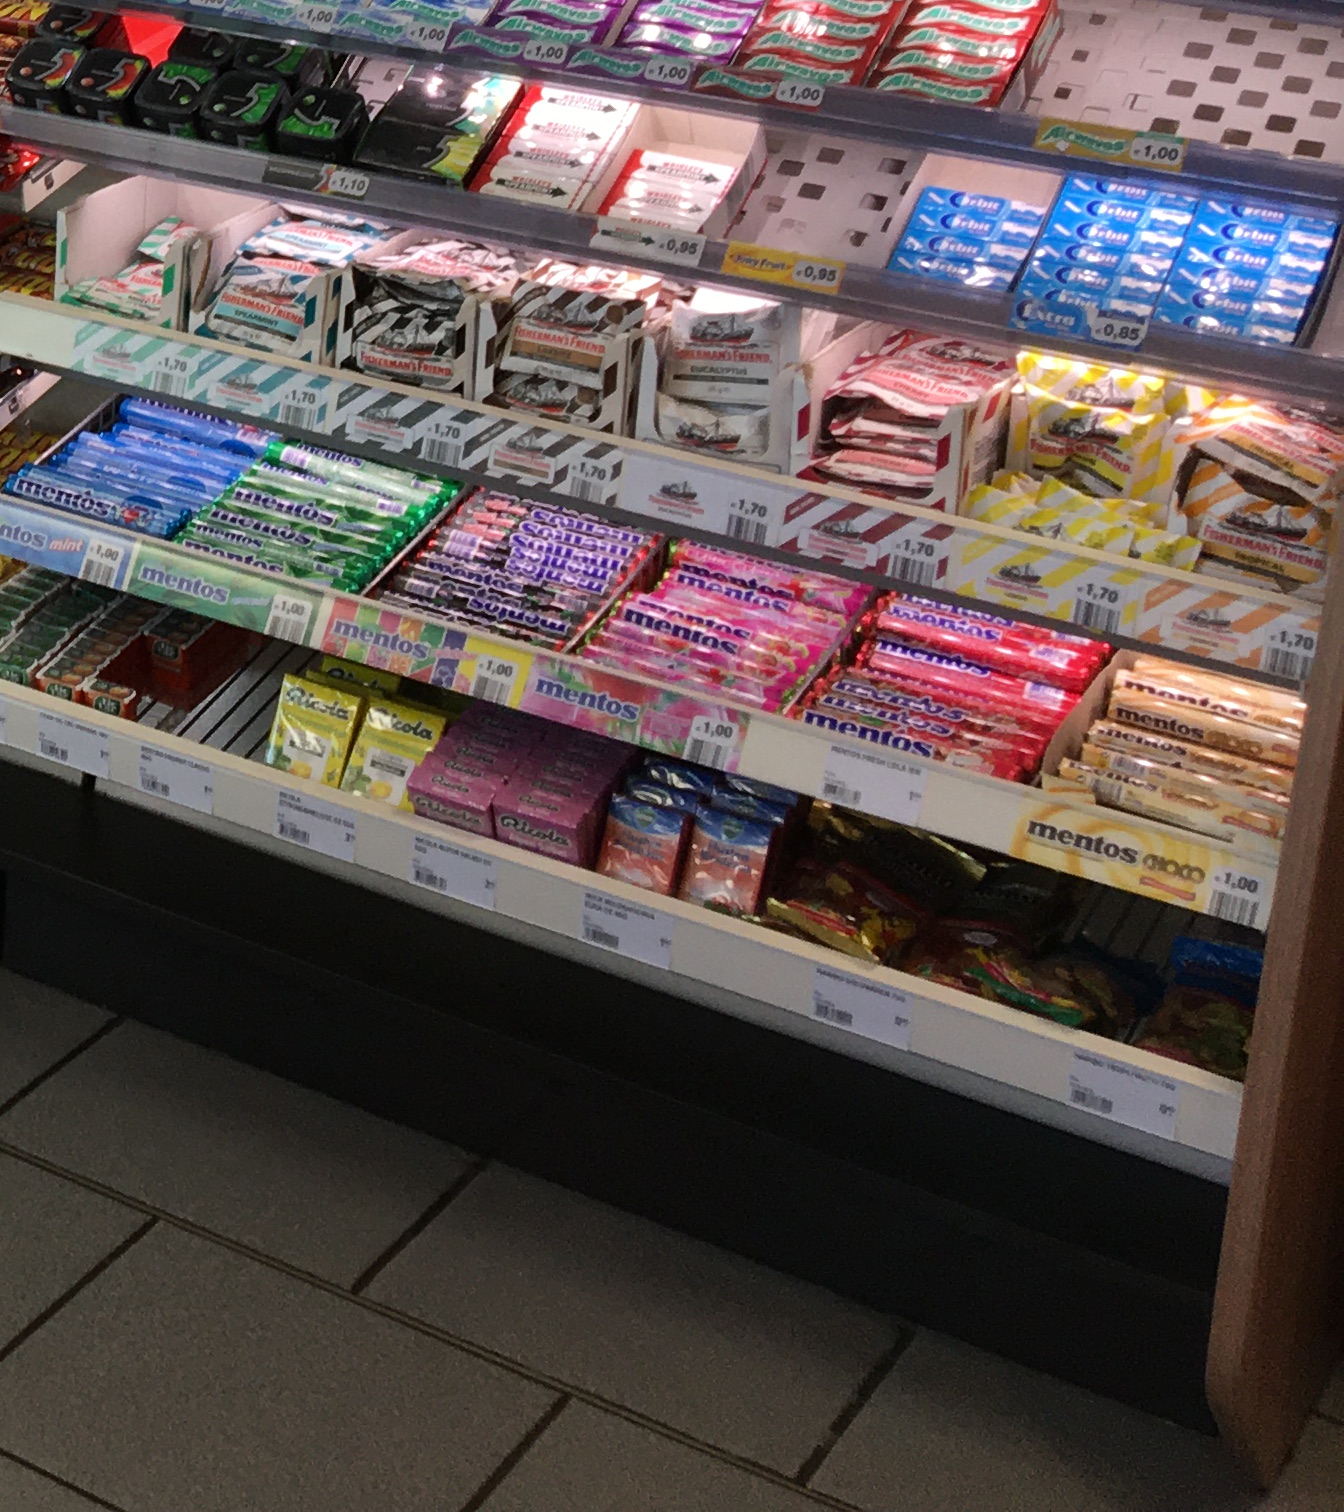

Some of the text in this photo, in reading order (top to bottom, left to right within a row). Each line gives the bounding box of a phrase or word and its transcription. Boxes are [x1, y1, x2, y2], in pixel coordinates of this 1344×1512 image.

[952, 192, 1000, 212] Orbit
[1088, 201, 1139, 221] Orbit
[274, 306, 305, 325] FRIEND
[49, 537, 84, 555] mint
[140, 565, 231, 605] mentos
[331, 618, 429, 661] mentos
[285, 687, 352, 721] Ricola
[498, 814, 570, 847] Ricola
[1027, 818, 1139, 866] mentos
